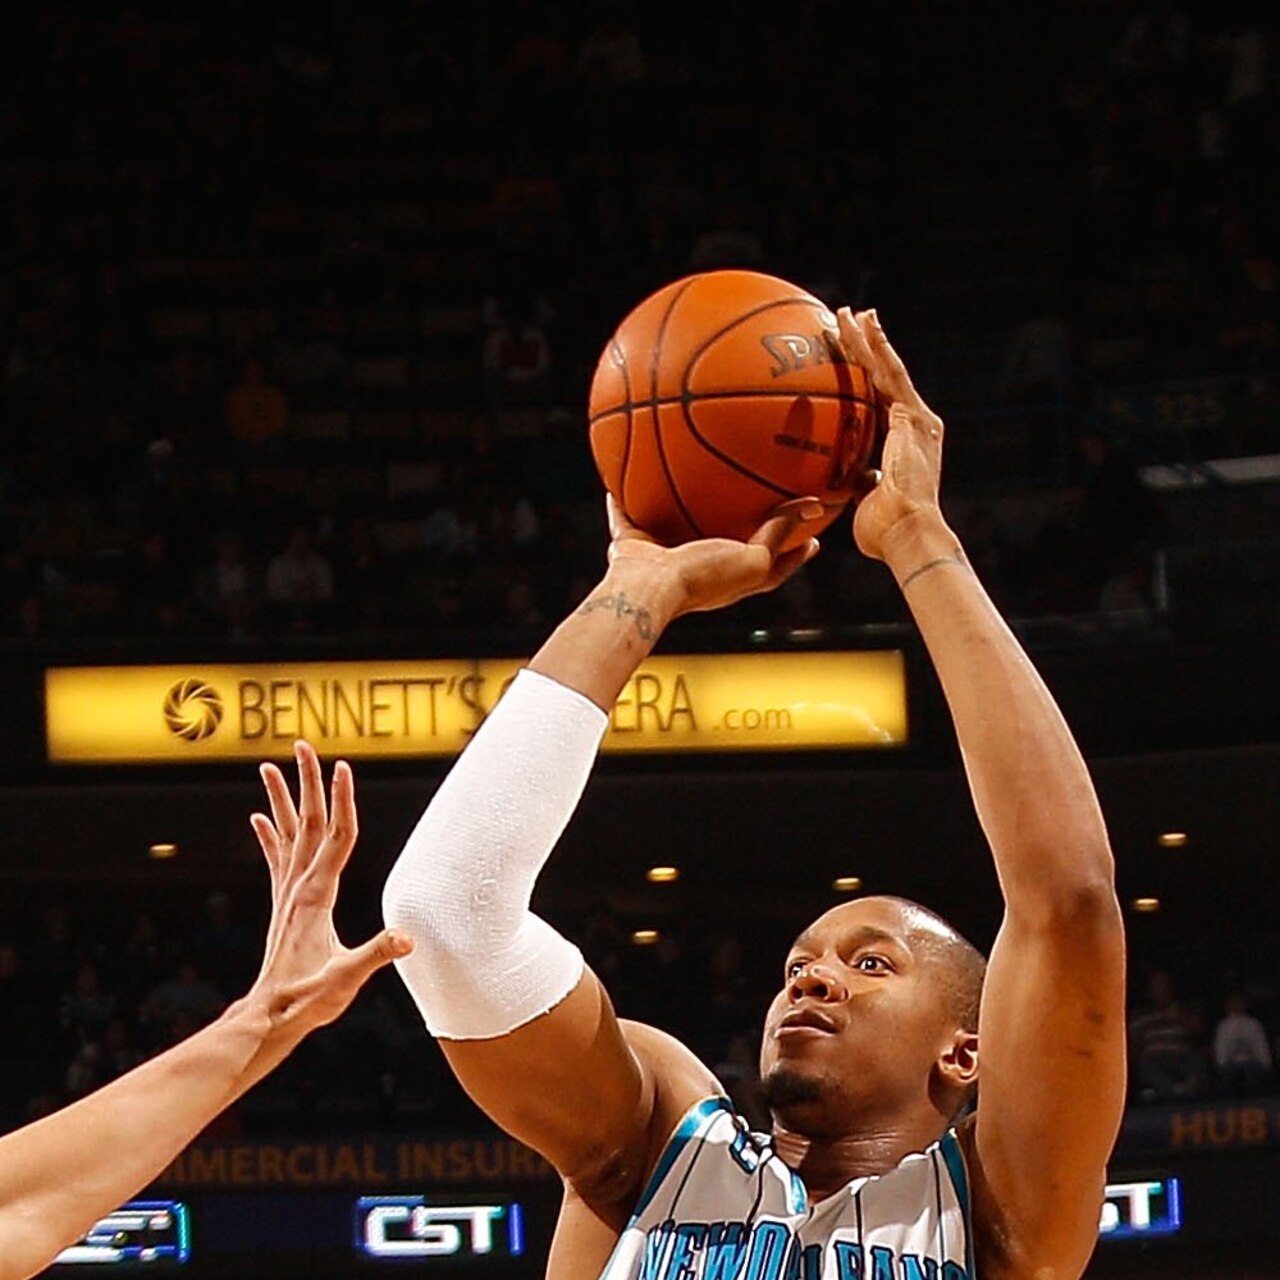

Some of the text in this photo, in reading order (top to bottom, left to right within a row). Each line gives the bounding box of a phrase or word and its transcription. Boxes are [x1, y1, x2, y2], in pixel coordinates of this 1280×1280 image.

[239, 676, 486, 738] BENNETT'S
[1172, 1108, 1267, 1146] HUB
[363, 1204, 503, 1257] CST
